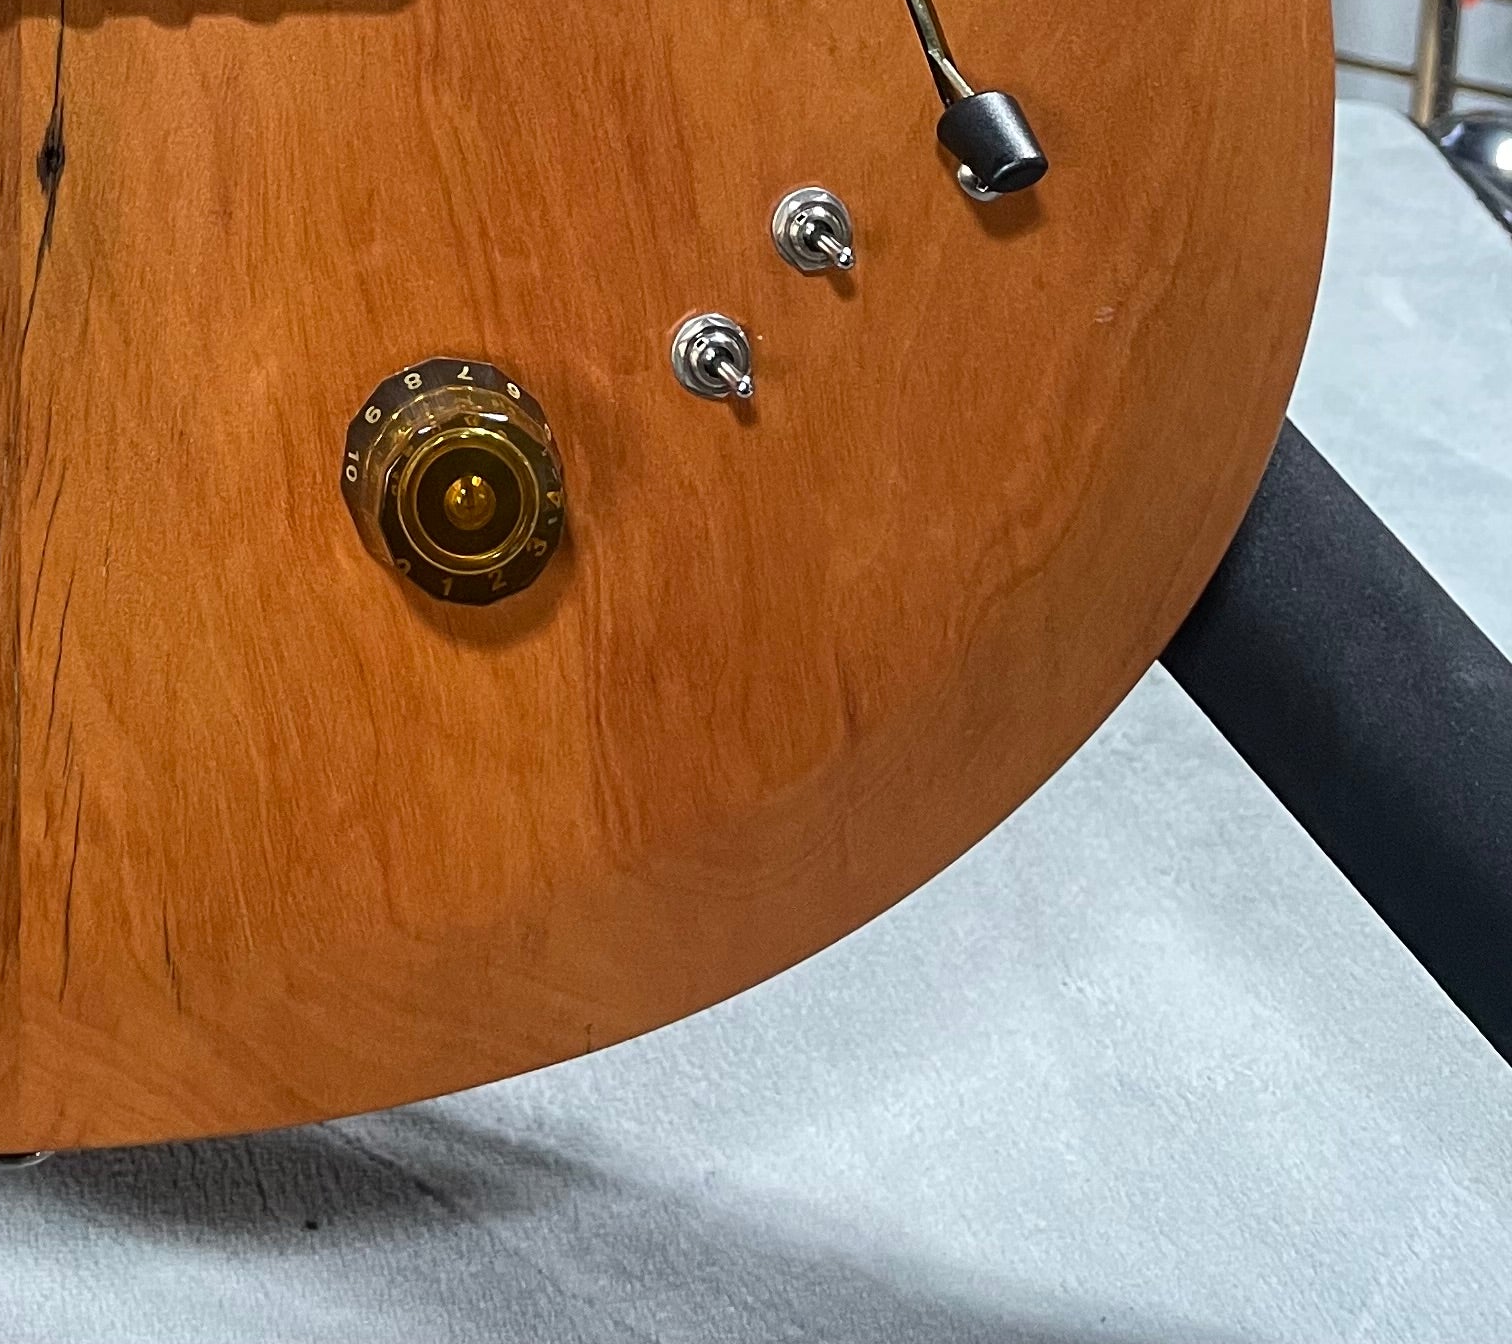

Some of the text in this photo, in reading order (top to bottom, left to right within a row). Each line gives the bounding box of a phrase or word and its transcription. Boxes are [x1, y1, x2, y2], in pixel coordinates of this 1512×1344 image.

[404, 373, 423, 390] 8
[458, 366, 473, 381] 7
[507, 382, 521, 400] 6
[365, 406, 382, 424] 9
[345, 451, 360, 483] 10
